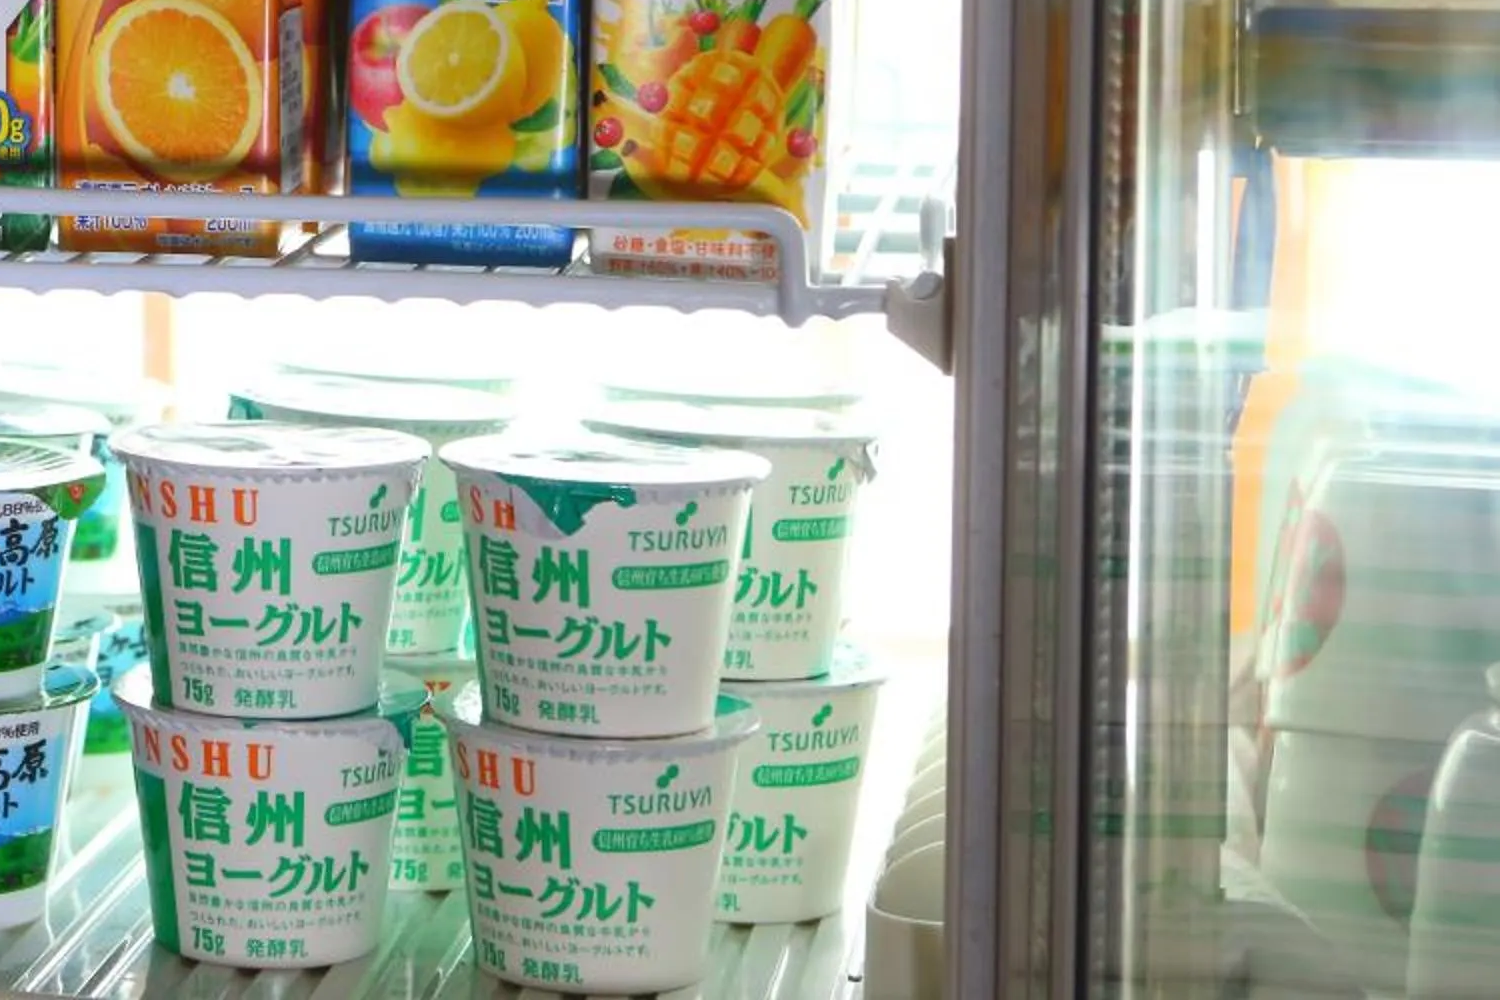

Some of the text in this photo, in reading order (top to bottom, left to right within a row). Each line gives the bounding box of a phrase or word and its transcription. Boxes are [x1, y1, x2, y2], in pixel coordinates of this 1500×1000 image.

[169, 529, 291, 595] 信州
[628, 525, 727, 552] TSURUYA
[479, 535, 589, 607] 信州
[174, 599, 362, 646] ヨーグルト
[487, 607, 671, 662] ヨーグルト
[182, 677, 298, 709] 75g 発酵乳
[494, 685, 600, 724] 75g 発酵乳
[767, 725, 858, 752] TSURUYA
[457, 741, 535, 796] SHU
[179, 781, 305, 847] 信州
[607, 786, 712, 815] TSURUYA
[467, 791, 571, 869] 信州
[185, 850, 370, 898] ヨーグルト
[393, 859, 427, 882] 75g
[473, 862, 655, 923] ヨーグルト
[192, 928, 309, 959] 75g 発酵乳
[522, 957, 584, 984] 発酵乳
